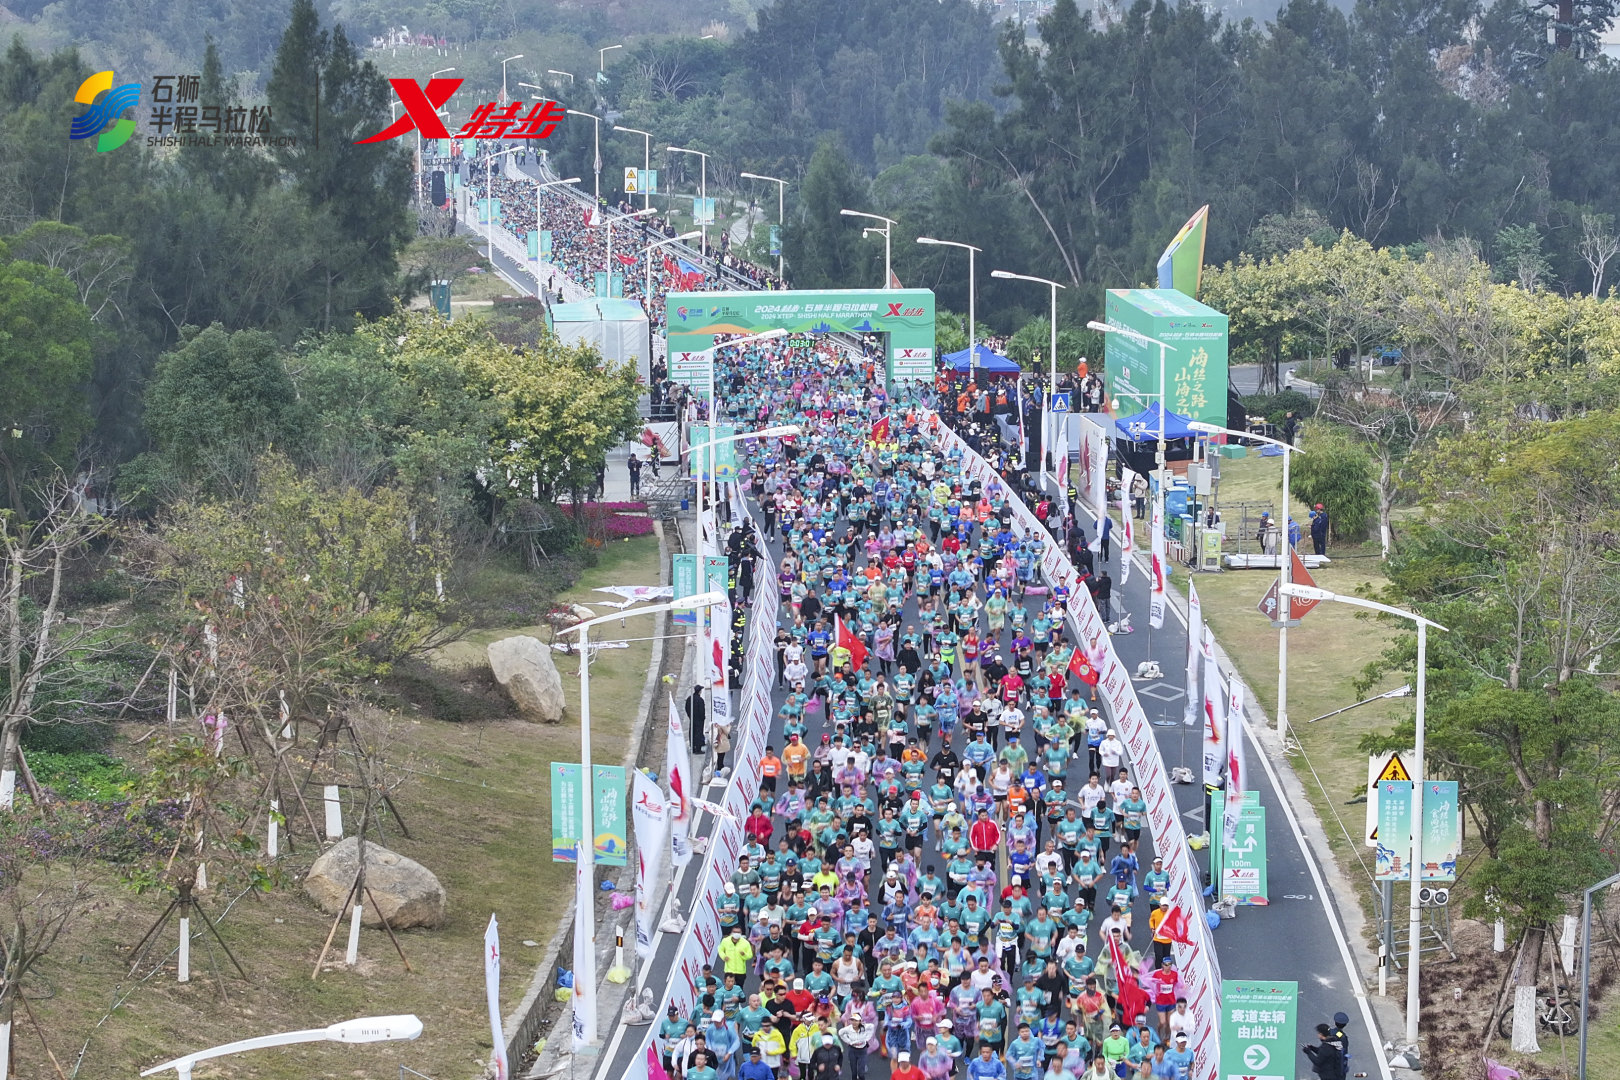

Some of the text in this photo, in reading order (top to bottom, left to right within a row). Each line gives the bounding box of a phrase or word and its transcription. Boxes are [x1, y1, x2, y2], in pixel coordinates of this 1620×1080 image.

[1245, 823, 1255, 834] 男
[1231, 1008, 1286, 1024] 赛道车辆
[1237, 1025, 1278, 1040] 由此出
